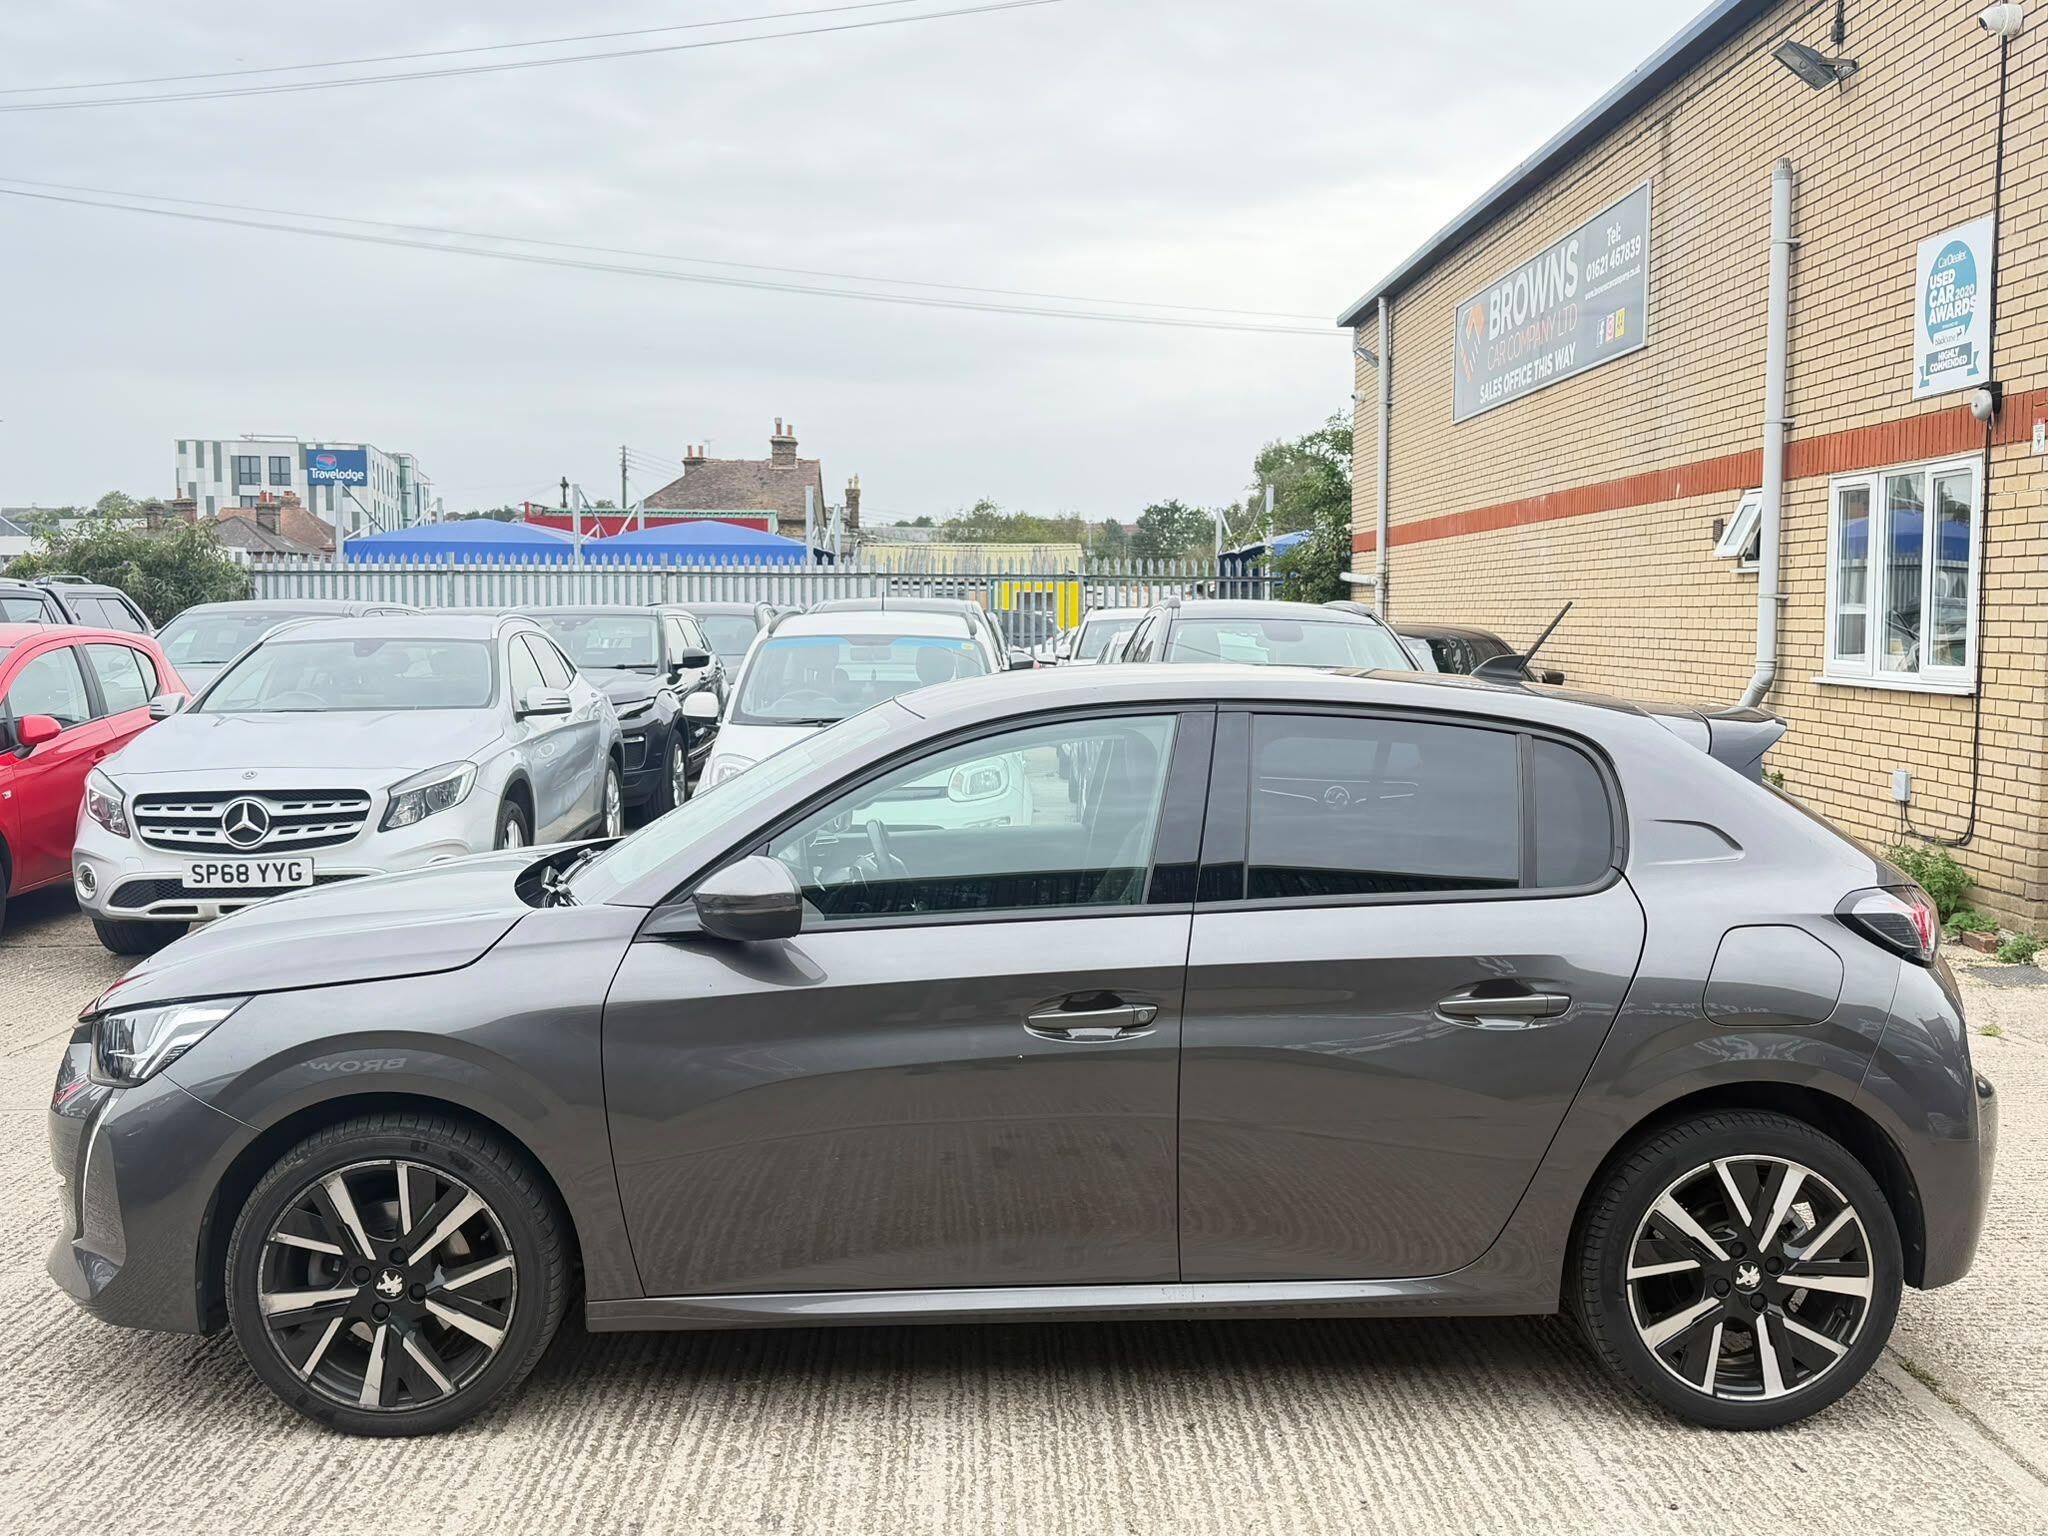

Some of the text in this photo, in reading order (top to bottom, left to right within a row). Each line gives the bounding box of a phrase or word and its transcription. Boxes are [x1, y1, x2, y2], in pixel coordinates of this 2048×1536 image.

[1607, 222, 1621, 247] Tel:
[1586, 235, 1641, 282] 01621 467839
[1488, 239, 1579, 341] BROWNS
[1929, 268, 1956, 290] USED
[1929, 283, 1975, 309] CAR 2020
[1928, 294, 1977, 326] AWARDS
[1488, 303, 1578, 371] CAR COMPANY LTD
[1930, 354, 1968, 373] COMMENDED
[1937, 347, 1960, 361] HIGHLY
[1480, 341, 1576, 404] SALES OFFICE THIS WAY
[309, 467, 365, 482] Travelodge
[191, 862, 302, 884] SP68 YYG
